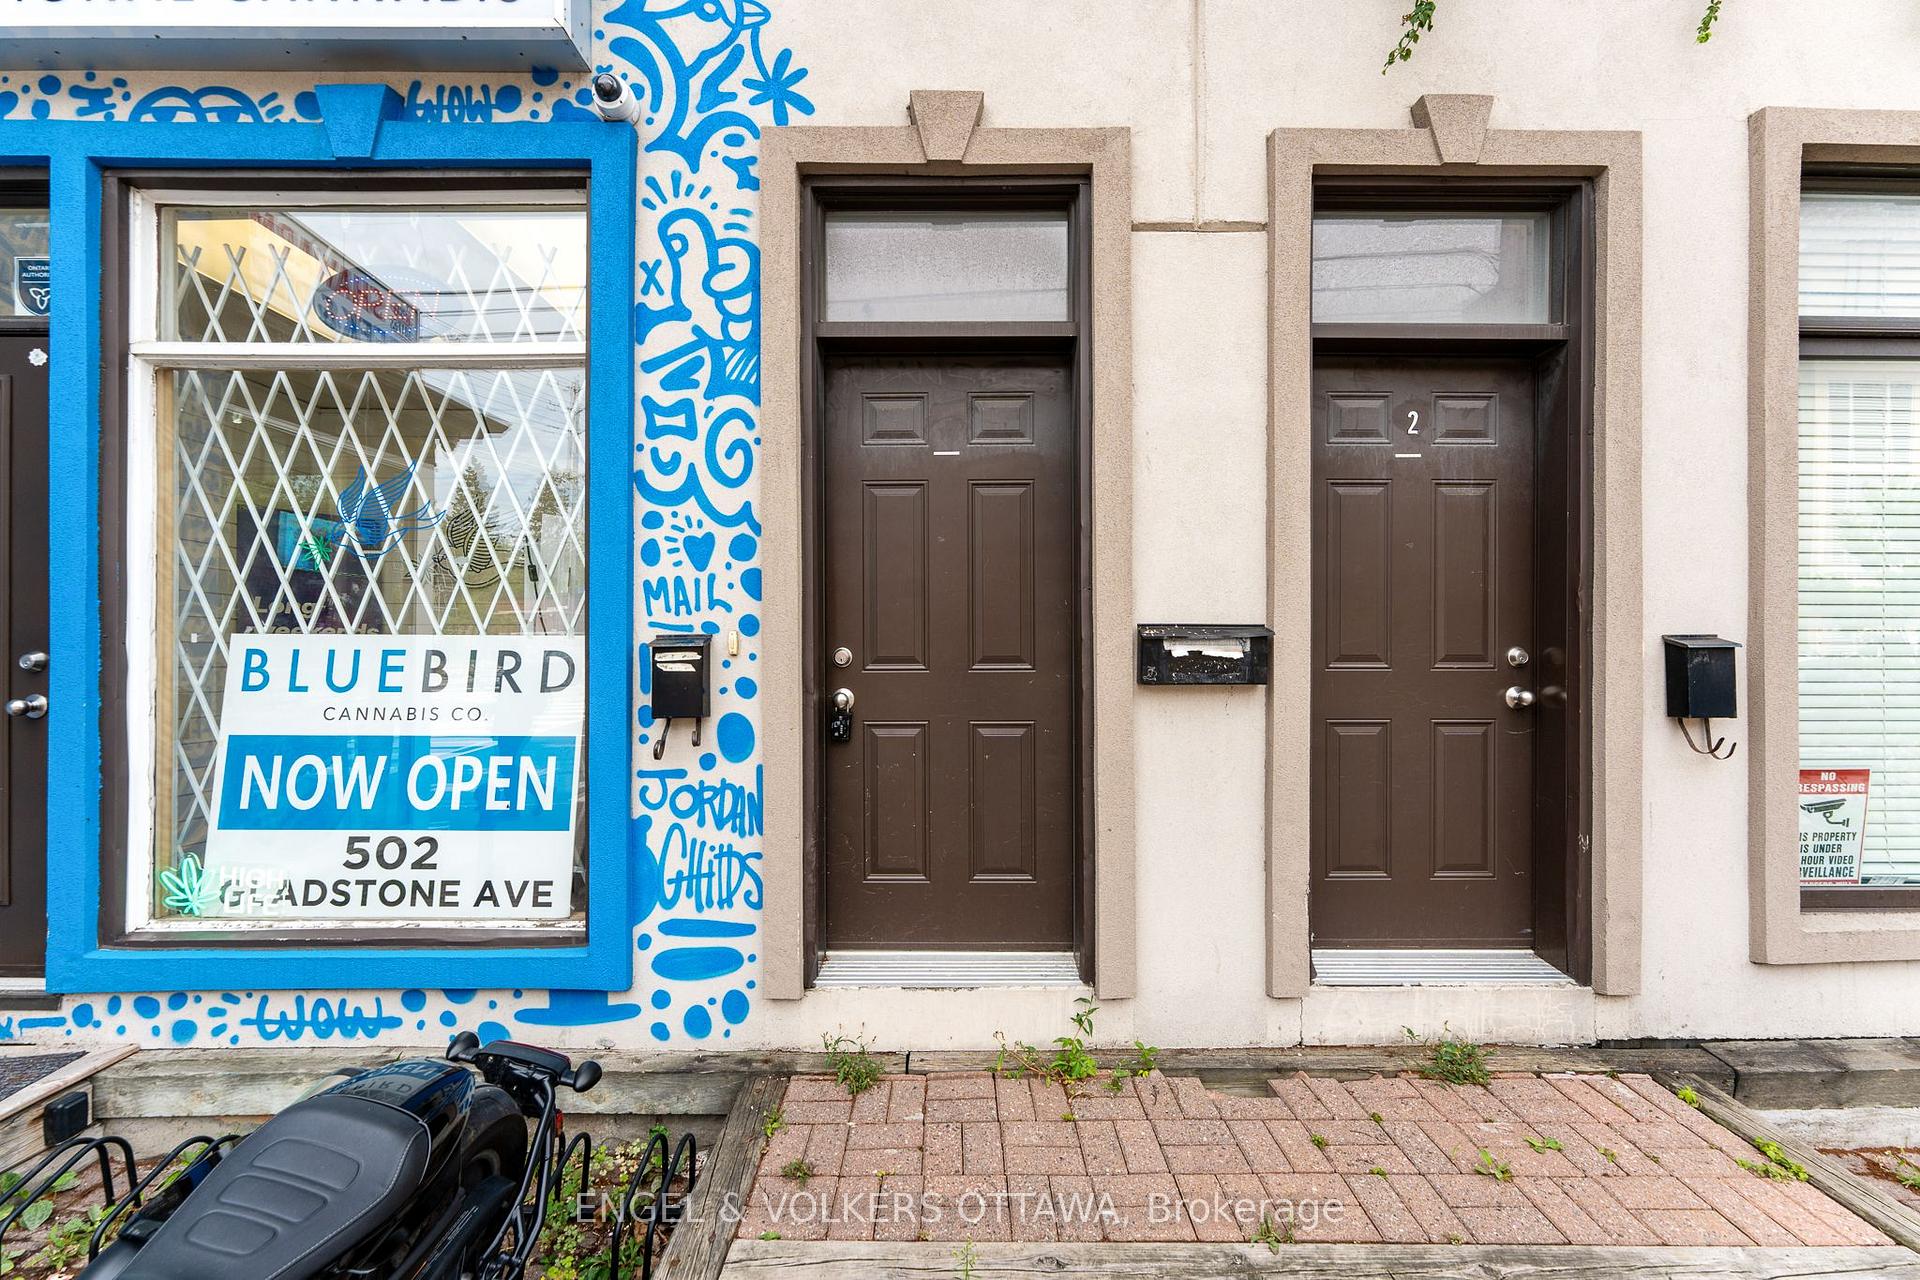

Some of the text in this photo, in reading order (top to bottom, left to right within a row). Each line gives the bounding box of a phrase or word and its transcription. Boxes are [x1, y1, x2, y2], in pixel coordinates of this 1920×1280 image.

[1407, 410, 1419, 435] 2
[643, 573, 732, 617] MAIL
[241, 648, 576, 694] BLUEBIRD
[322, 706, 489, 722] CANNABIS CO.
[239, 754, 557, 811] NOW OPEN
[1821, 772, 1837, 781] NO
[1812, 832, 1857, 842] PROPERTY
[1813, 843, 1842, 853] UNDER
[342, 836, 439, 870] 502
[1801, 855, 1854, 865] HOUR VIDEO
[473, 879, 553, 908] AVE
[253, 994, 385, 1041] WOW
